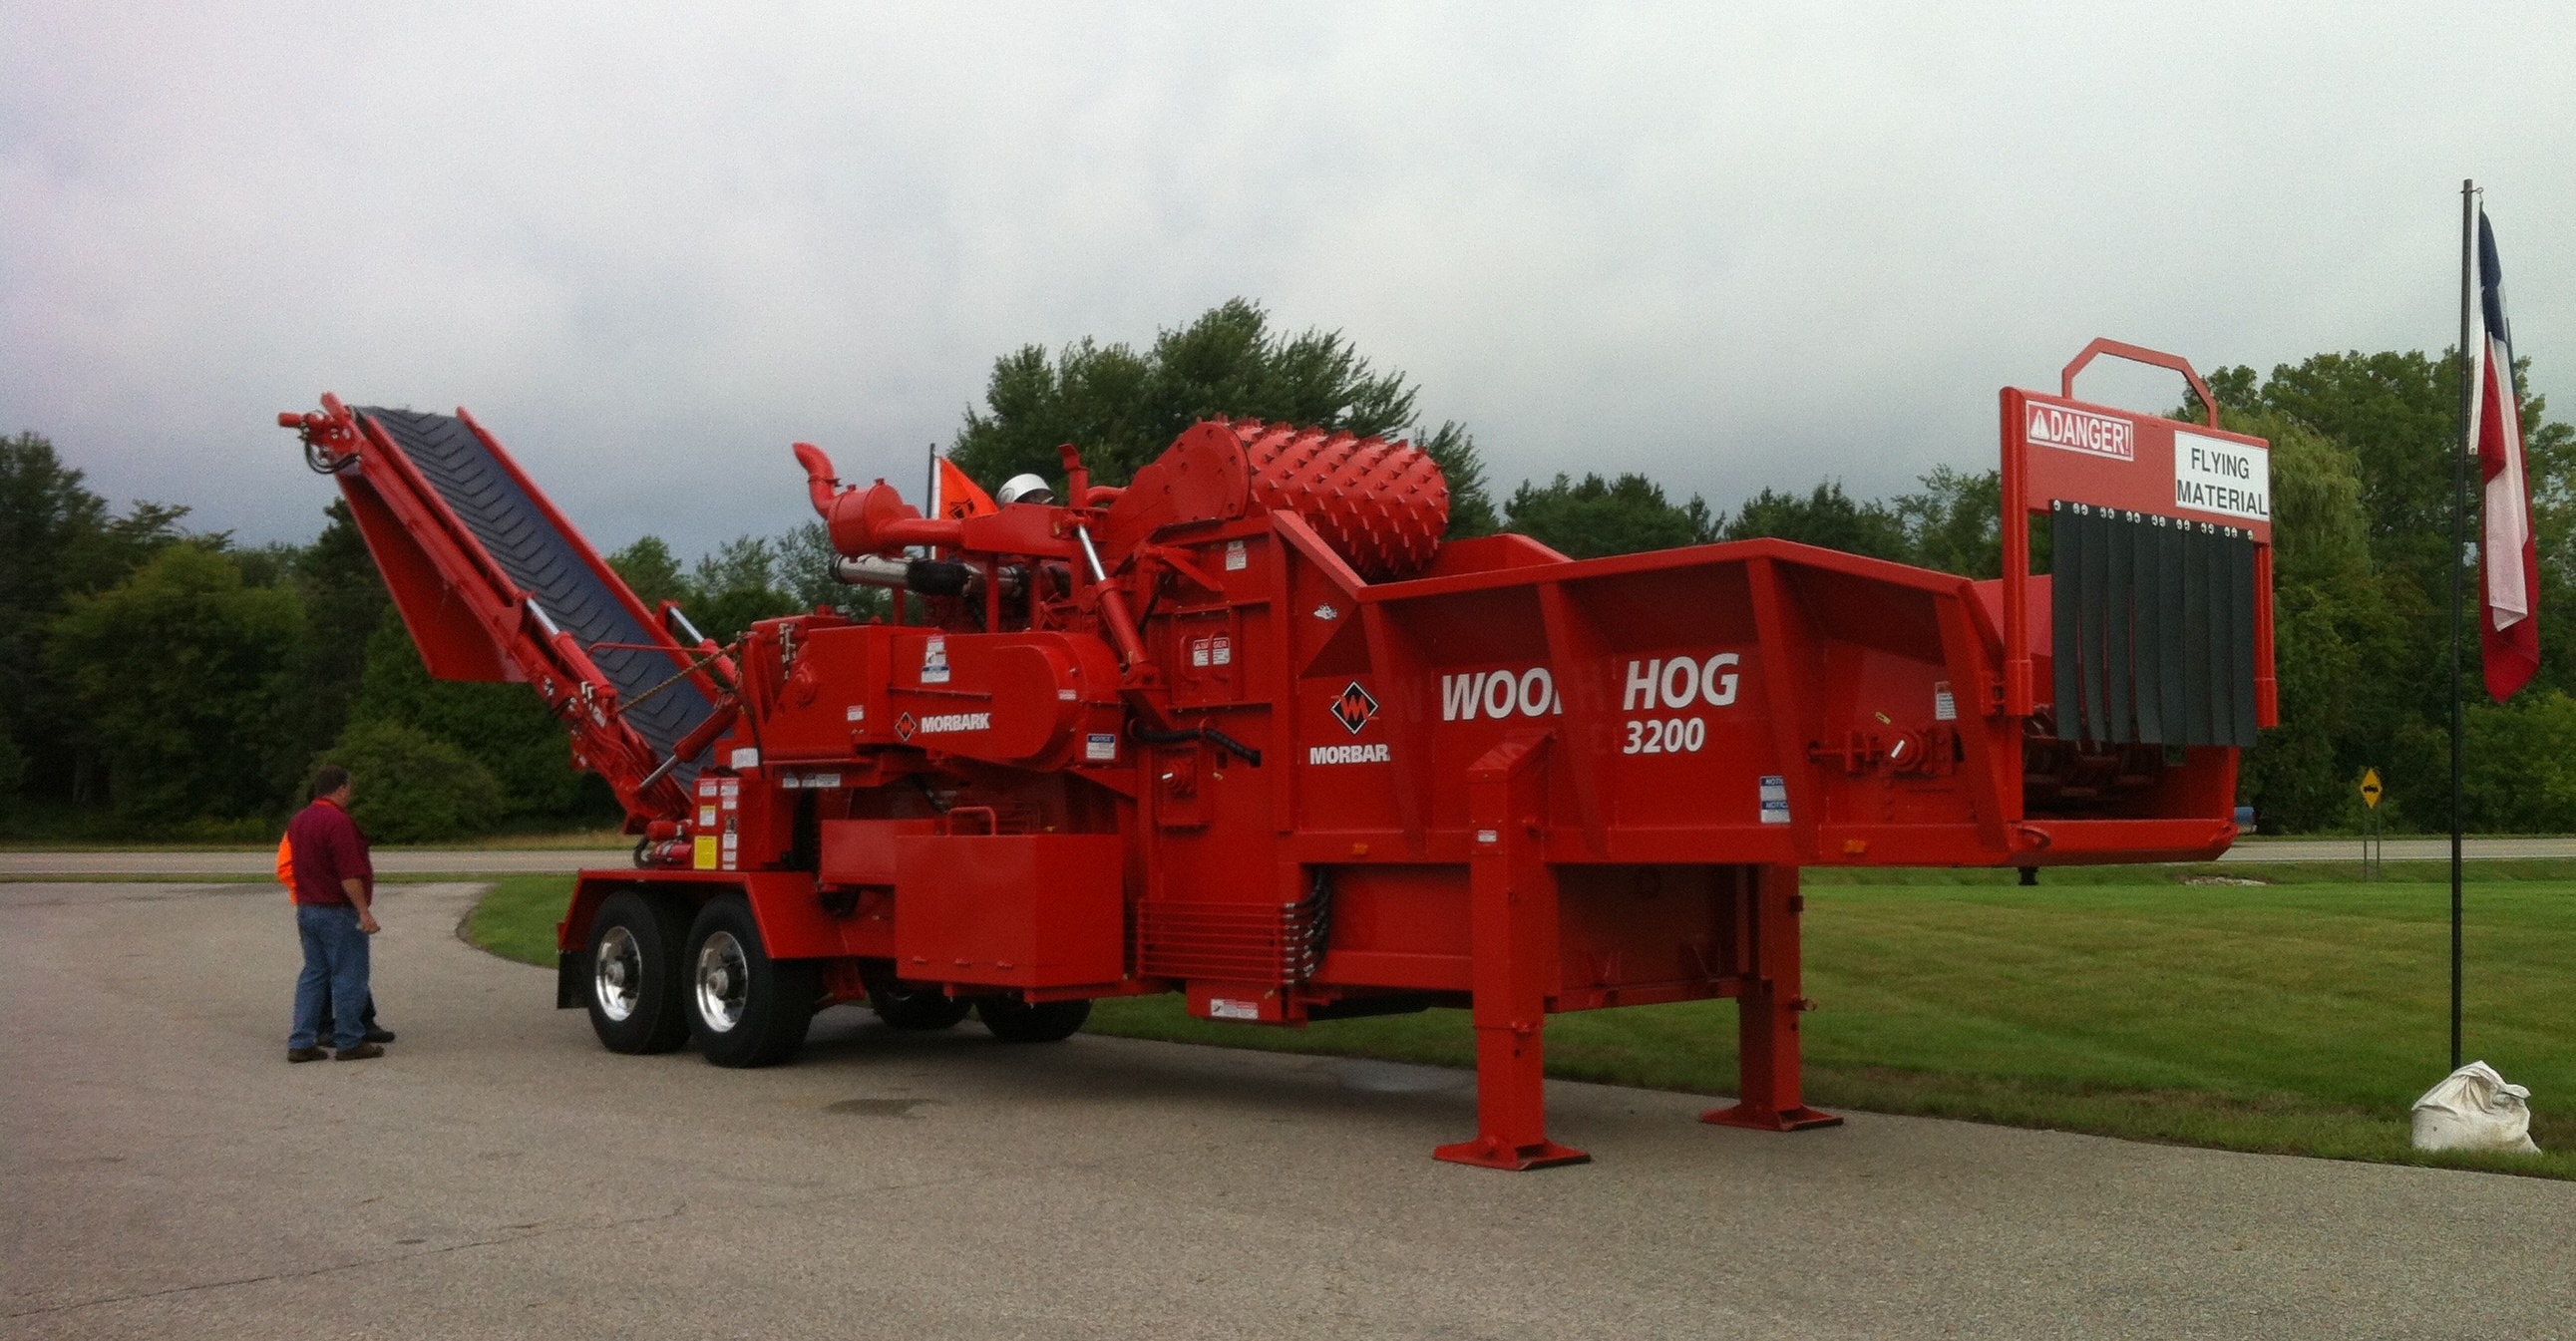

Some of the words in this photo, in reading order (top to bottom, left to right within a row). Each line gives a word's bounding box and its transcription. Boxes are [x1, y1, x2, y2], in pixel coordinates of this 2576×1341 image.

[2049, 410, 2130, 455] DANGER!
[2191, 447, 2250, 480] FLYING
[2177, 479, 2269, 515] MATERIAL
[1442, 667, 1563, 721] WOO
[1623, 652, 1740, 711] HOG
[920, 712, 991, 733] MORBARK
[1623, 717, 1705, 755] 3200
[1309, 743, 1391, 765] MORBAR
